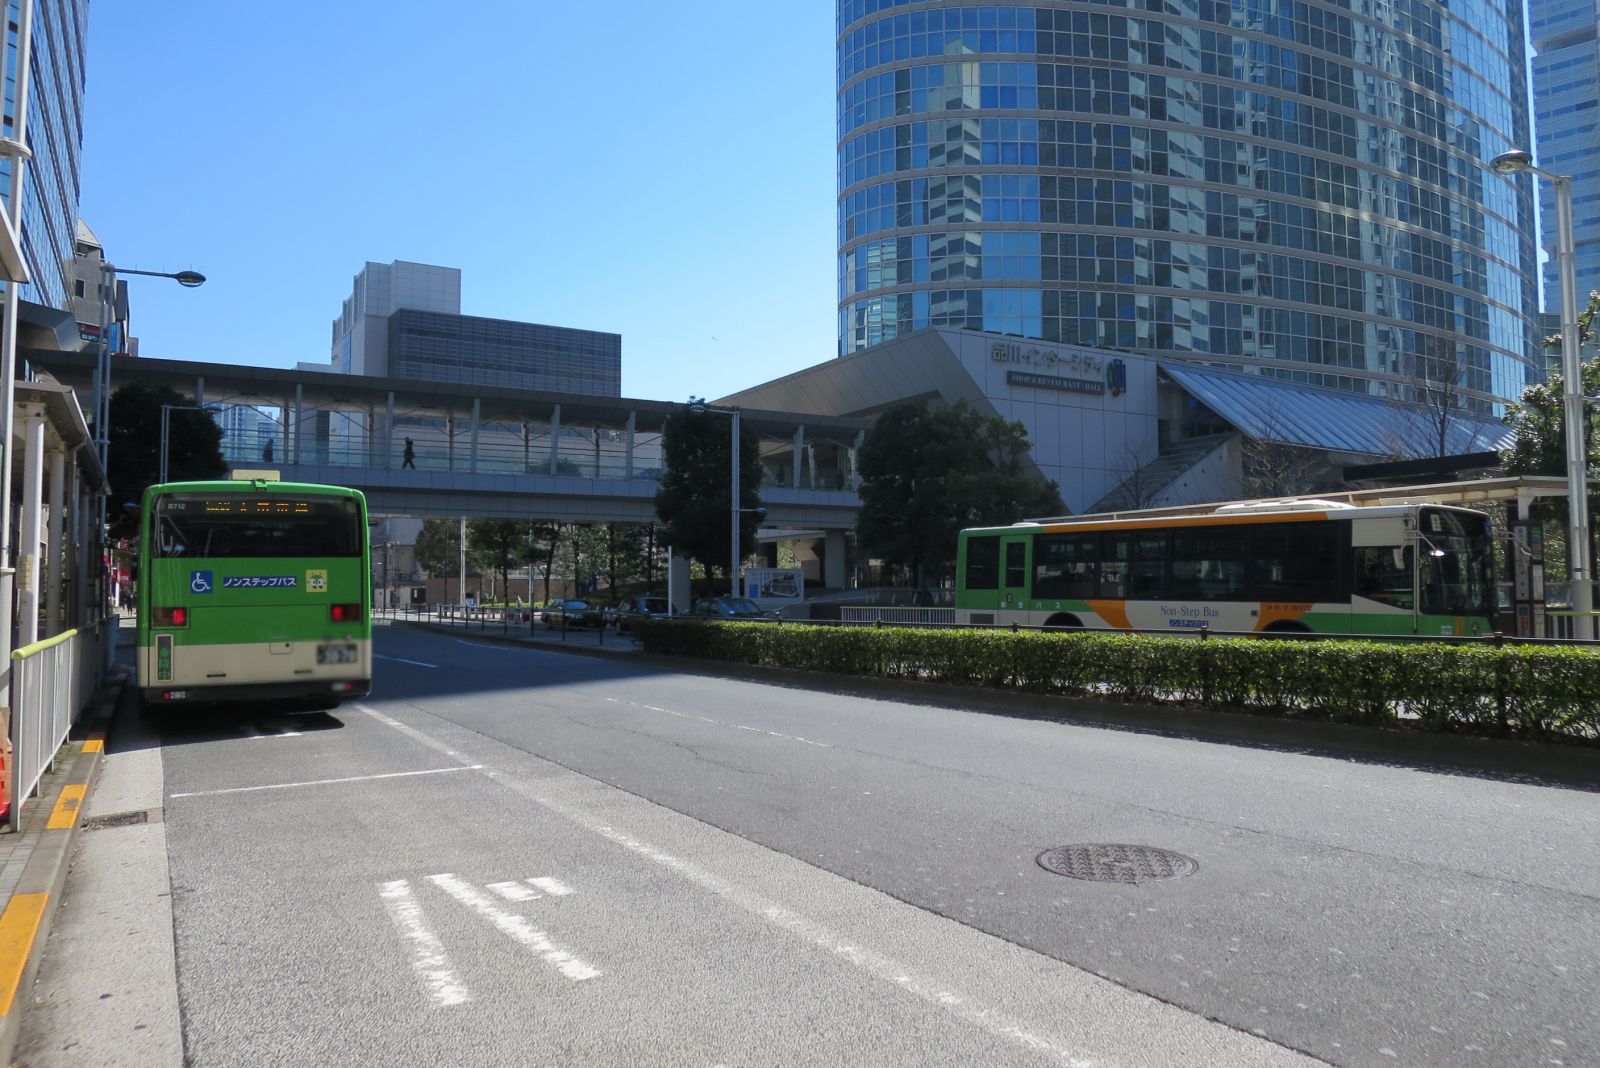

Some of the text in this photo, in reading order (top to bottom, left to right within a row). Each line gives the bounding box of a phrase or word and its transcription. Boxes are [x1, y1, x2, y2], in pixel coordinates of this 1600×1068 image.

[992, 342, 1101, 374] 品川インターシティ
[223, 577, 296, 587] ノンステップバス
[1203, 607, 1219, 617] Bus
